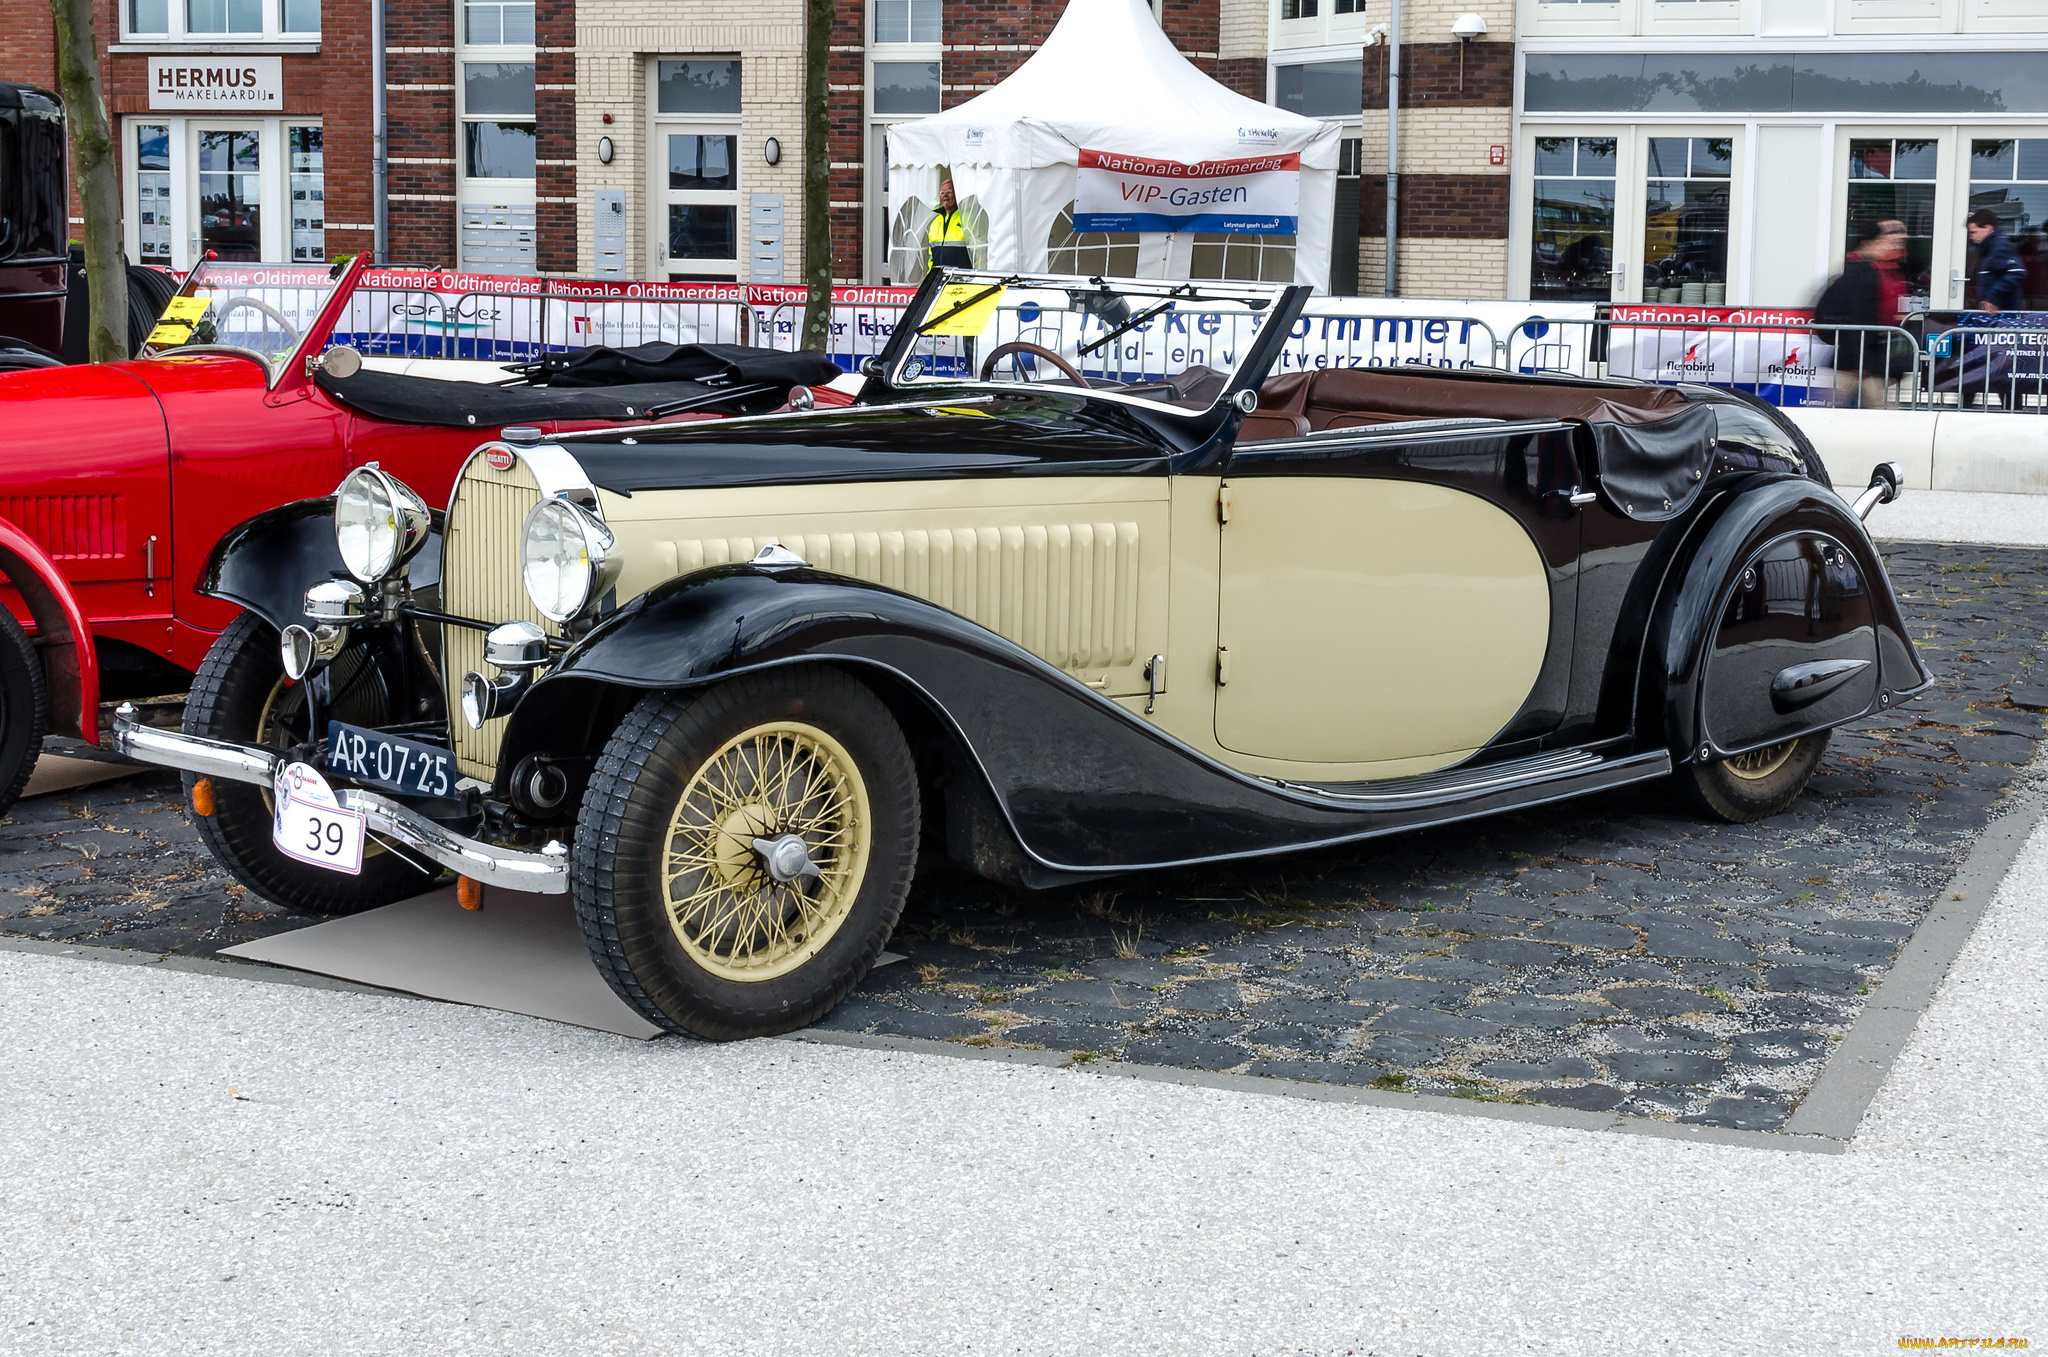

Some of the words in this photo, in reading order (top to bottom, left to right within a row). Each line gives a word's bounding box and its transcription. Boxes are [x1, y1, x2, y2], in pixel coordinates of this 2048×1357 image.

[158, 68, 257, 88] HERMUS
[176, 89, 266, 100] MAKELAARDIJ
[1097, 154, 1182, 176] Nationale
[1187, 158, 1282, 177] Oldtimerdag
[1121, 182, 1247, 206] VIP-Gasten
[173, 271, 249, 285] Nonale
[253, 270, 336, 286] Oldtimer
[358, 271, 437, 289] Nationale
[442, 274, 540, 294] Oldtimerdag
[550, 281, 621, 296] Nationale
[627, 284, 739, 299] Oldtimerdag
[749, 286, 838, 302] Natione
[843, 288, 915, 303] Oldtime
[392, 304, 441, 316] GDF
[1612, 308, 1720, 323] Nationale
[1728, 309, 1815, 325] Oldtim
[635, 321, 660, 330] Llysta
[662, 322, 675, 331] City
[1974, 333, 2016, 345] MUCO
[1171, 348, 1204, 364] en
[1799, 398, 1826, 406] Leystad
[487, 453, 509, 465] BUGATTI
[305, 817, 344, 856] 39
